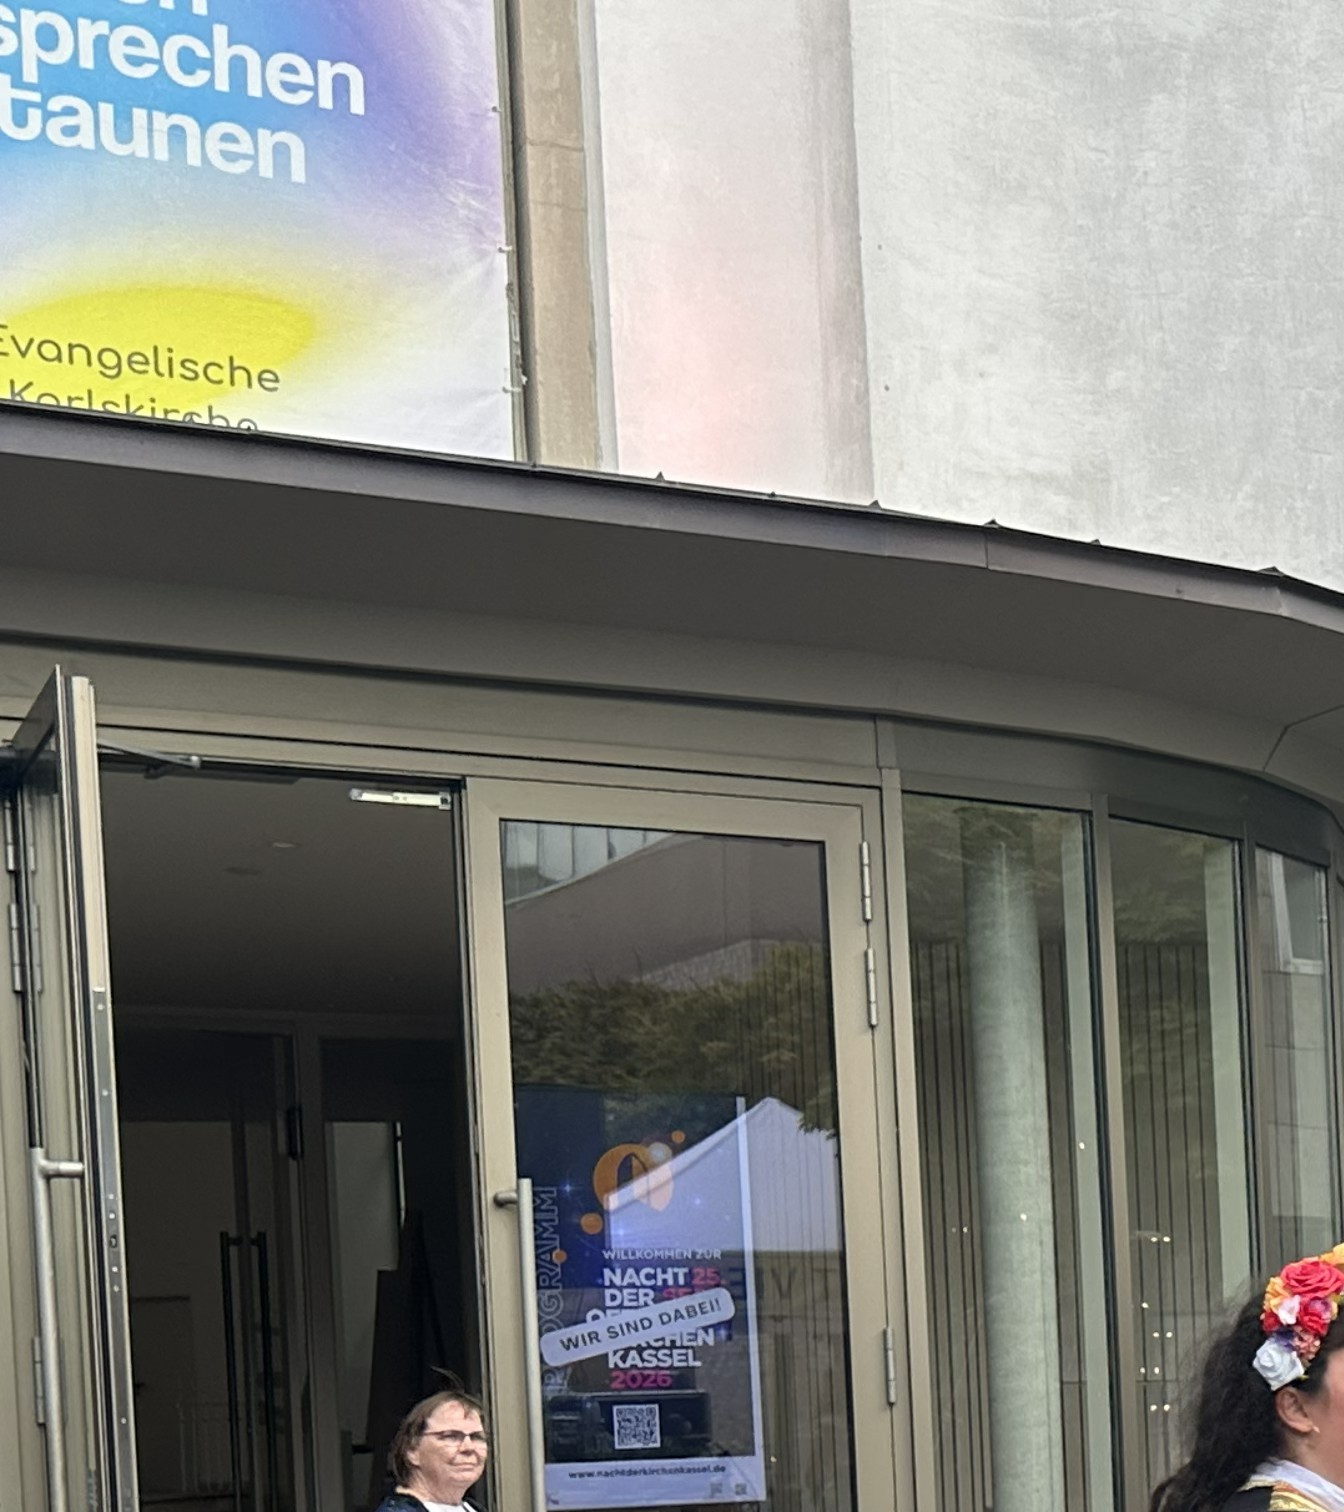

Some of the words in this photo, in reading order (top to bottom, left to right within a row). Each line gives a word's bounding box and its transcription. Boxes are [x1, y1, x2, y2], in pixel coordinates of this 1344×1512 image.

[602, 1250, 692, 1261] WILLKOMMEN
[695, 1250, 722, 1260] ZUR
[603, 1267, 689, 1287] NACHT
[605, 1288, 656, 1307] DER
[560, 1332, 601, 1353] WIR
[606, 1316, 654, 1340] SIND
[659, 1297, 722, 1326] DABEI!
[608, 1348, 703, 1369] KASSEL
[610, 1370, 673, 1390] 2026
